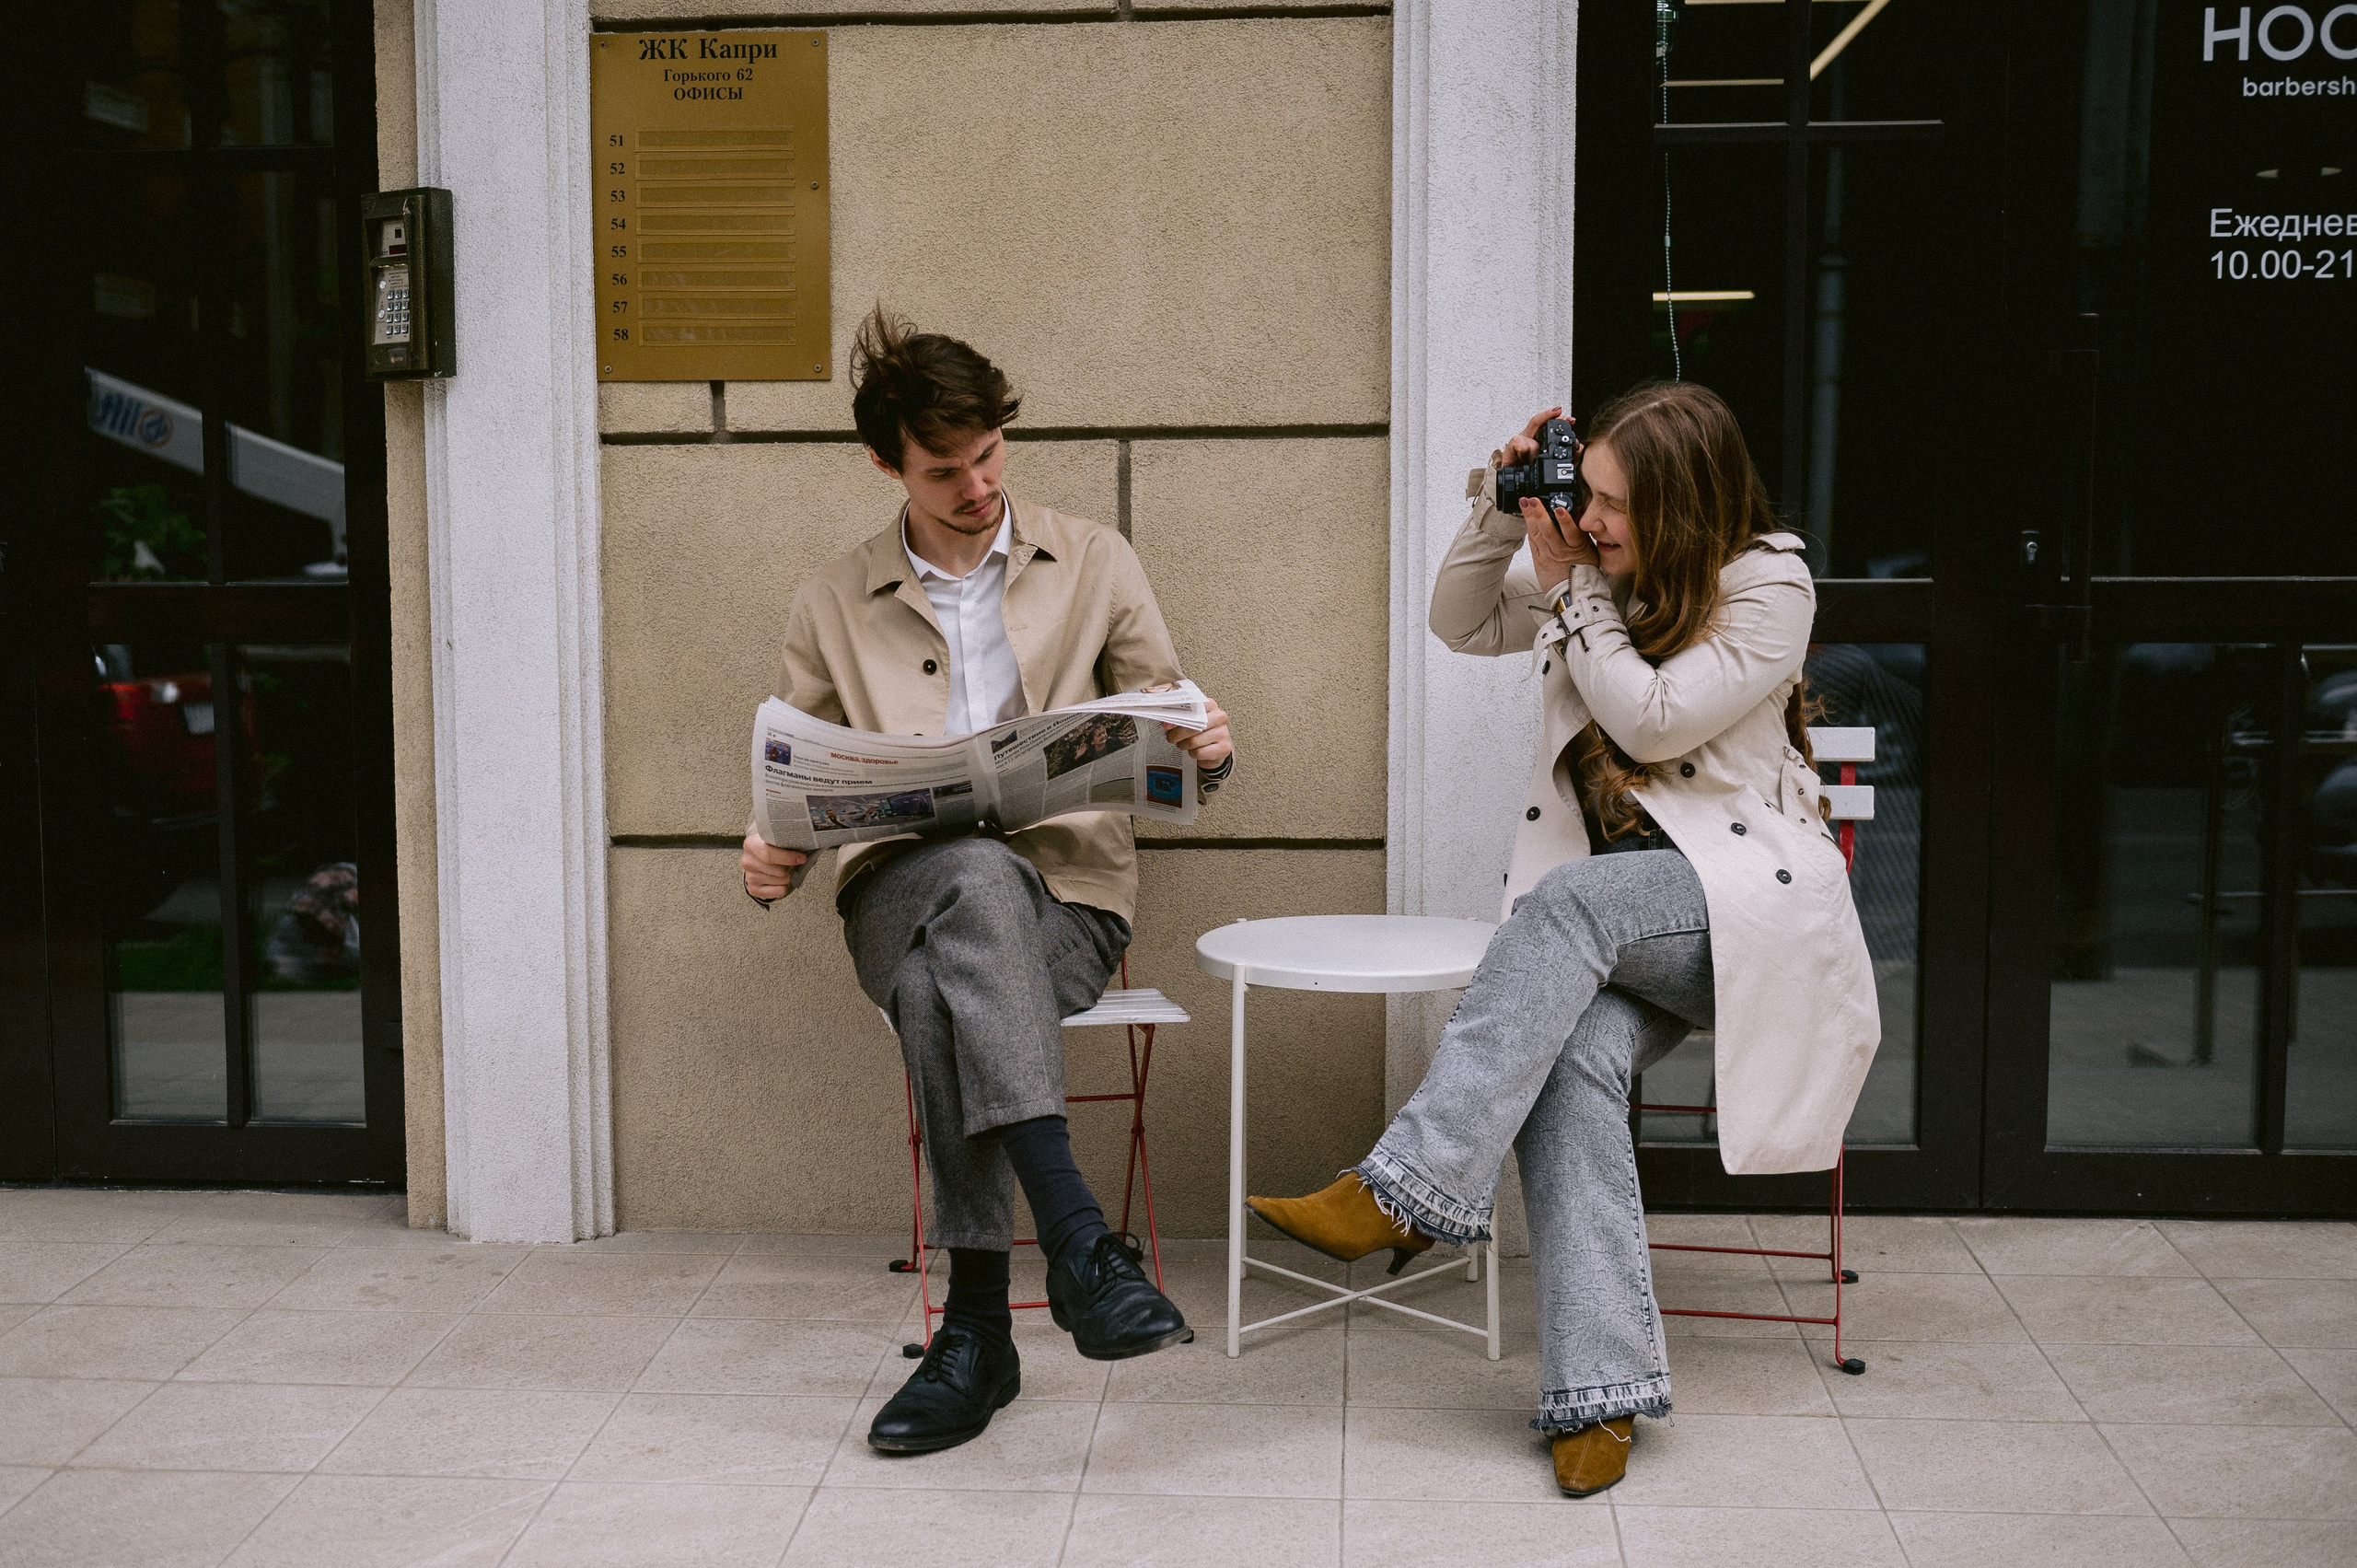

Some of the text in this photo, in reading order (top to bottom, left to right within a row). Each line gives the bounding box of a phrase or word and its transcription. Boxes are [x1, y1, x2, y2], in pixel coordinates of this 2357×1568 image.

[638, 38, 778, 64] ЖК Капри
[663, 67, 754, 85] Горького 62
[673, 87, 744, 101] ОФИСЫ
[609, 134, 625, 147] 51
[610, 162, 626, 175] 52
[610, 190, 626, 203] 53
[610, 217, 627, 231] 54
[610, 245, 627, 259] 55
[2211, 249, 2353, 280] 10.00-21
[611, 273, 628, 286] 56
[612, 300, 629, 314] 57
[613, 329, 630, 342] 58
[861, 757, 899, 765] здоровье
[764, 764, 812, 782] Флагманы
[812, 777, 841, 785] ведут
